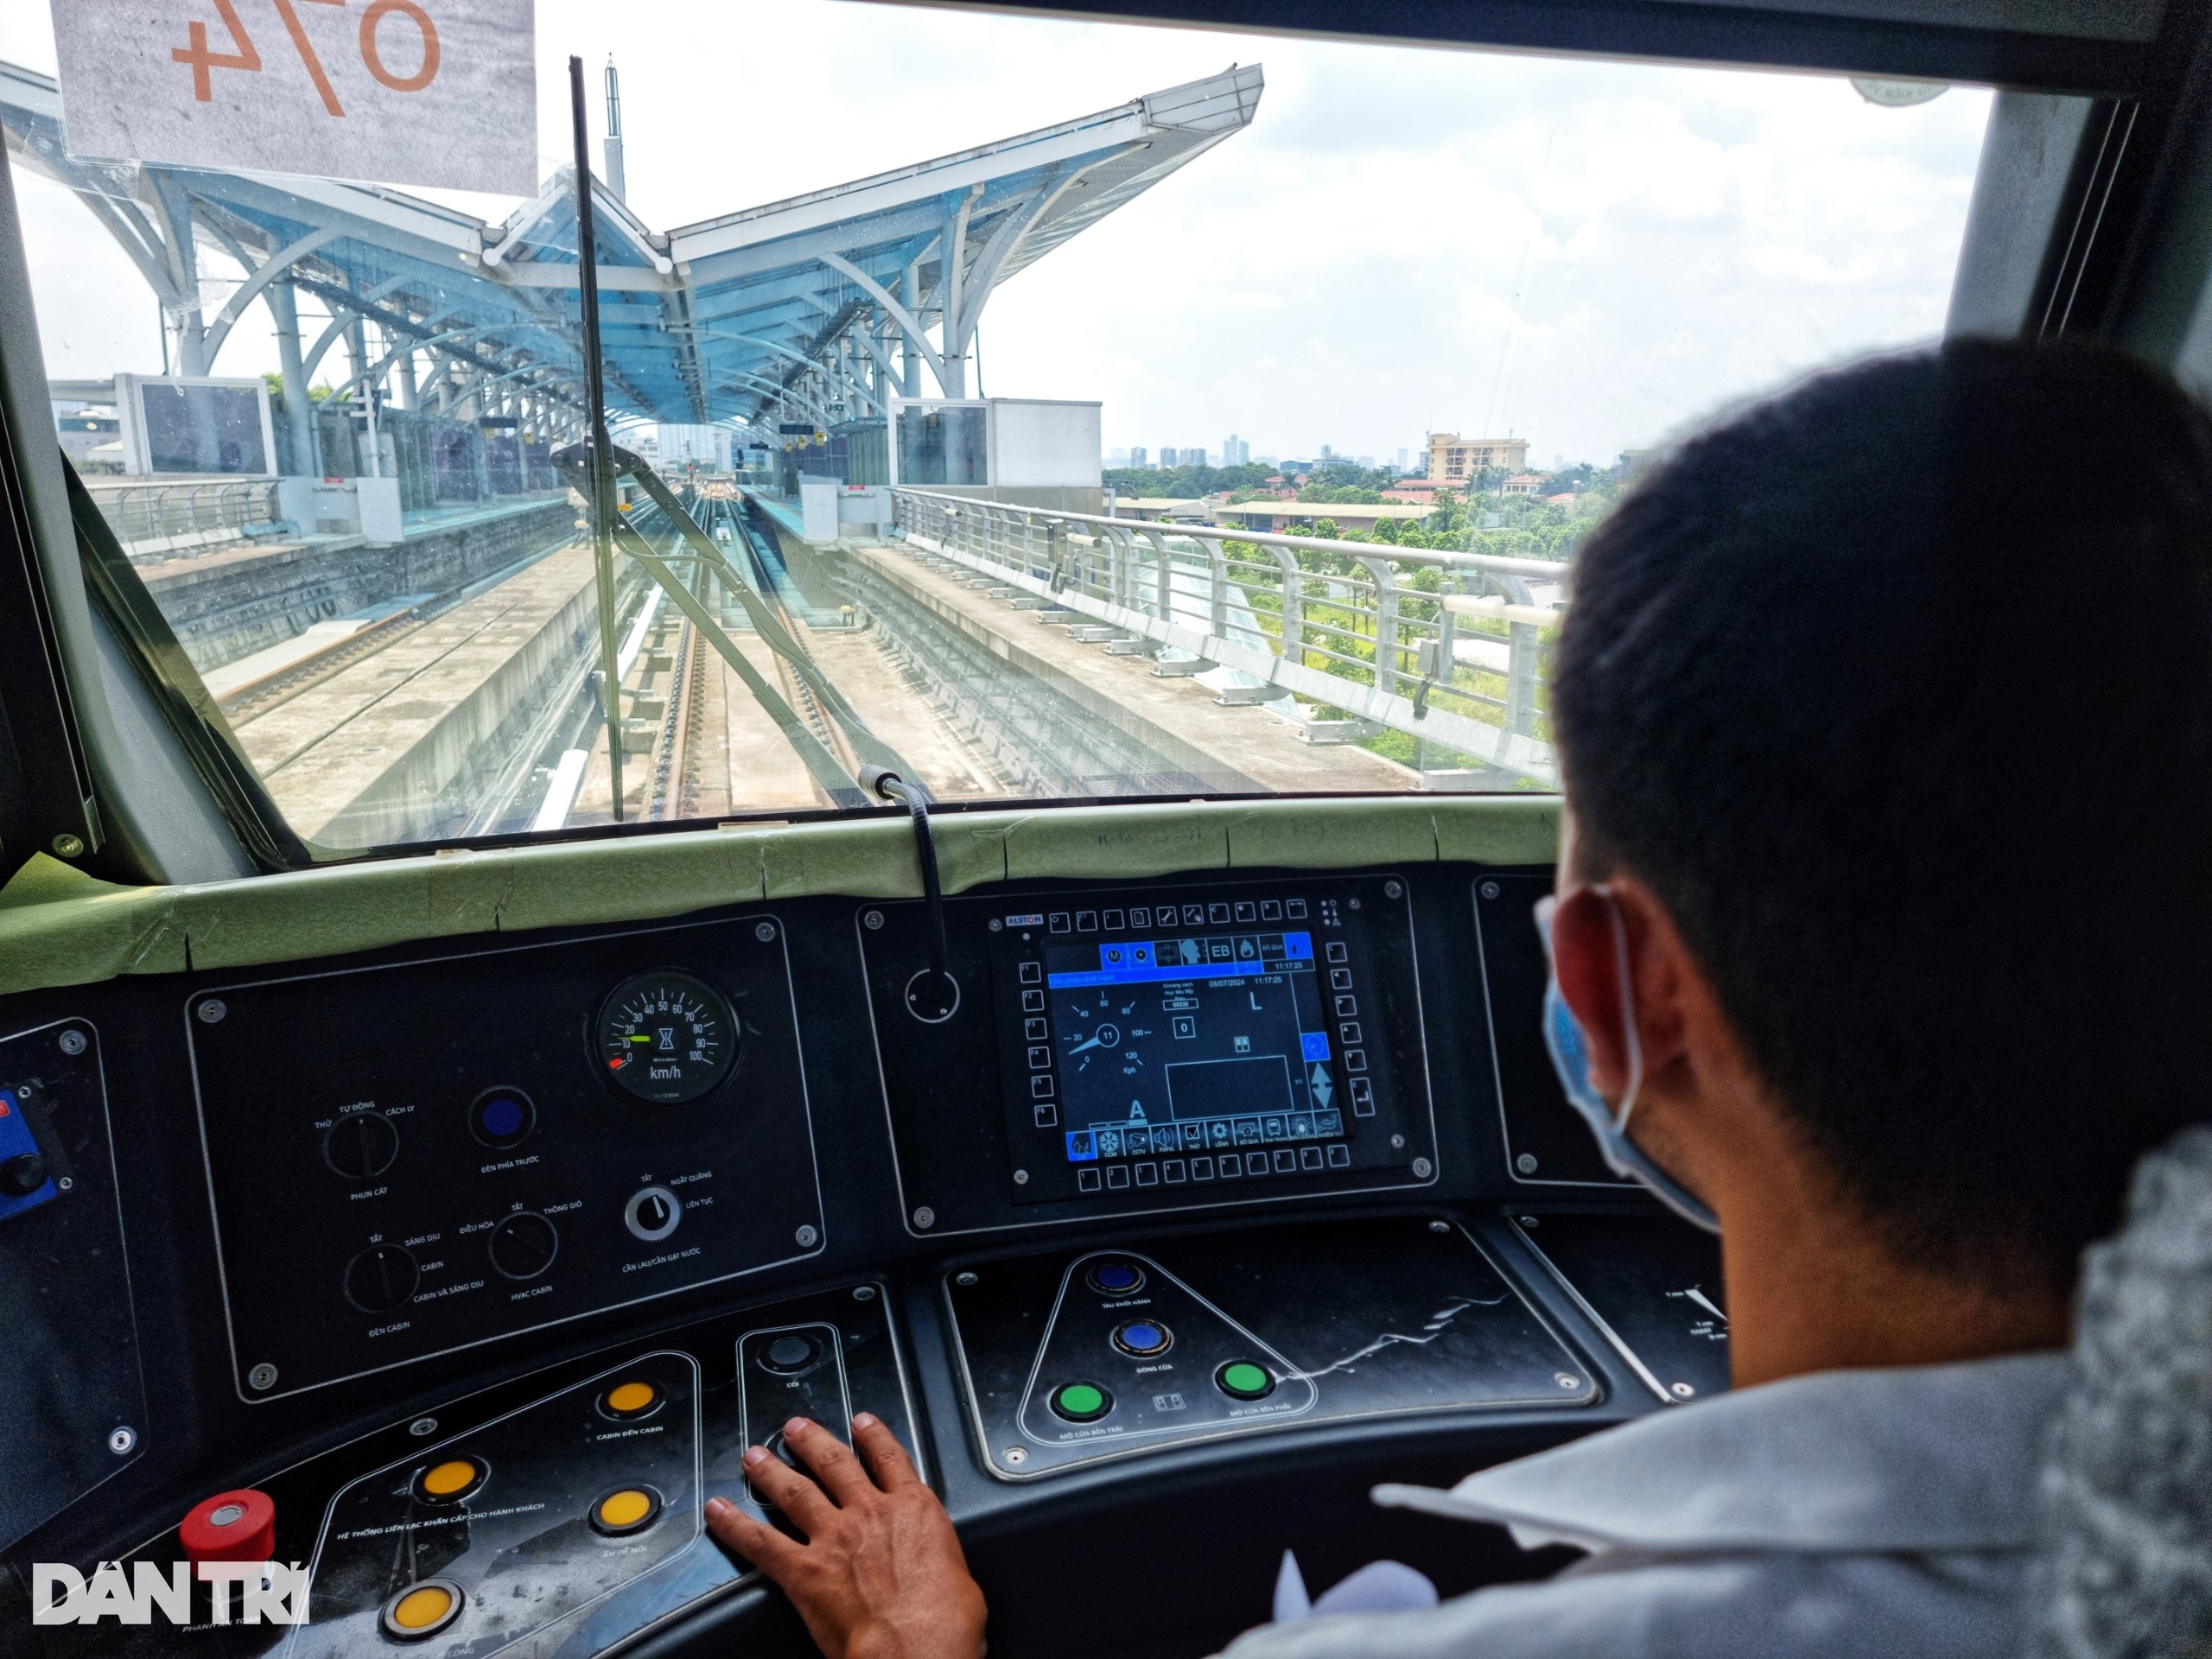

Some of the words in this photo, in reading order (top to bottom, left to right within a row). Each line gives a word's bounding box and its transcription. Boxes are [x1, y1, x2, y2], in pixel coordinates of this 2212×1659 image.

[1008, 916, 1041, 925] ALSTOM
[1211, 945, 1230, 957] EB
[1210, 979, 1245, 988] 08/07/2024
[645, 1004, 654, 1014] 40
[658, 1001, 668, 1011] 50
[673, 1004, 683, 1014] 60
[632, 1013, 643, 1022] 30
[685, 1012, 695, 1021] 70
[625, 1025, 635, 1034] 20
[693, 1024, 702, 1033] 80
[1181, 1022, 1188, 1033] 0
[622, 1039, 631, 1048] 10
[696, 1039, 706, 1048] 90
[626, 1052, 632, 1062] 0
[690, 1051, 702, 1061] 100
[650, 1065, 681, 1079] km/h
[1123, 1066, 1136, 1076] Kph
[339, 1105, 350, 1114] TỰ
[352, 1101, 375, 1111] ĐỘNG
[385, 1106, 406, 1116] CÁCH
[1130, 1099, 1146, 1118] A
[315, 1118, 333, 1128] THỬ
[480, 1164, 496, 1173] ĐÈN
[498, 1160, 515, 1170] PHÍA
[515, 1155, 540, 1166] TRƯỚC
[640, 1173, 652, 1183] TẮT
[671, 1175, 689, 1186] NGẮT
[350, 1191, 373, 1201] PHUN
[373, 1186, 388, 1196] CÁT
[511, 1202, 524, 1211] TẮT
[543, 1204, 569, 1215] THÔNG
[569, 1199, 582, 1210] GIÓ
[685, 1199, 700, 1210] LIÊN
[700, 1197, 714, 1205] TỤC
[460, 1224, 477, 1234] ĐIỀU
[478, 1220, 495, 1230] HÒA
[369, 1234, 383, 1243] TẮT
[404, 1236, 426, 1247] SÁNG
[427, 1233, 441, 1243] DỊU
[667, 1252, 680, 1262] GẠT
[681, 1247, 702, 1258] NƯỚC
[421, 1261, 444, 1272] CABIN
[413, 1292, 437, 1303] CABIN
[437, 1287, 448, 1297] VÀ
[448, 1284, 470, 1294] SÁNG
[470, 1280, 484, 1288] DỊU
[511, 1290, 531, 1301] HVAC
[531, 1284, 553, 1296] CABIN
[368, 1327, 385, 1338] ĐÈN
[386, 1321, 410, 1332] CABIN
[596, 1432, 620, 1440] CABIN
[622, 1428, 639, 1437] ĐẾN
[639, 1426, 664, 1434] CABIN
[352, 1527, 384, 1538] THỐNG
[385, 1523, 404, 1533] LIÊN
[405, 1521, 423, 1530] LẠC
[469, 1511, 488, 1520] CHO
[489, 1507, 514, 1517] HÀNH
[516, 1503, 545, 1514] KHÁCH
[182, 1622, 217, 1633] PHANH
